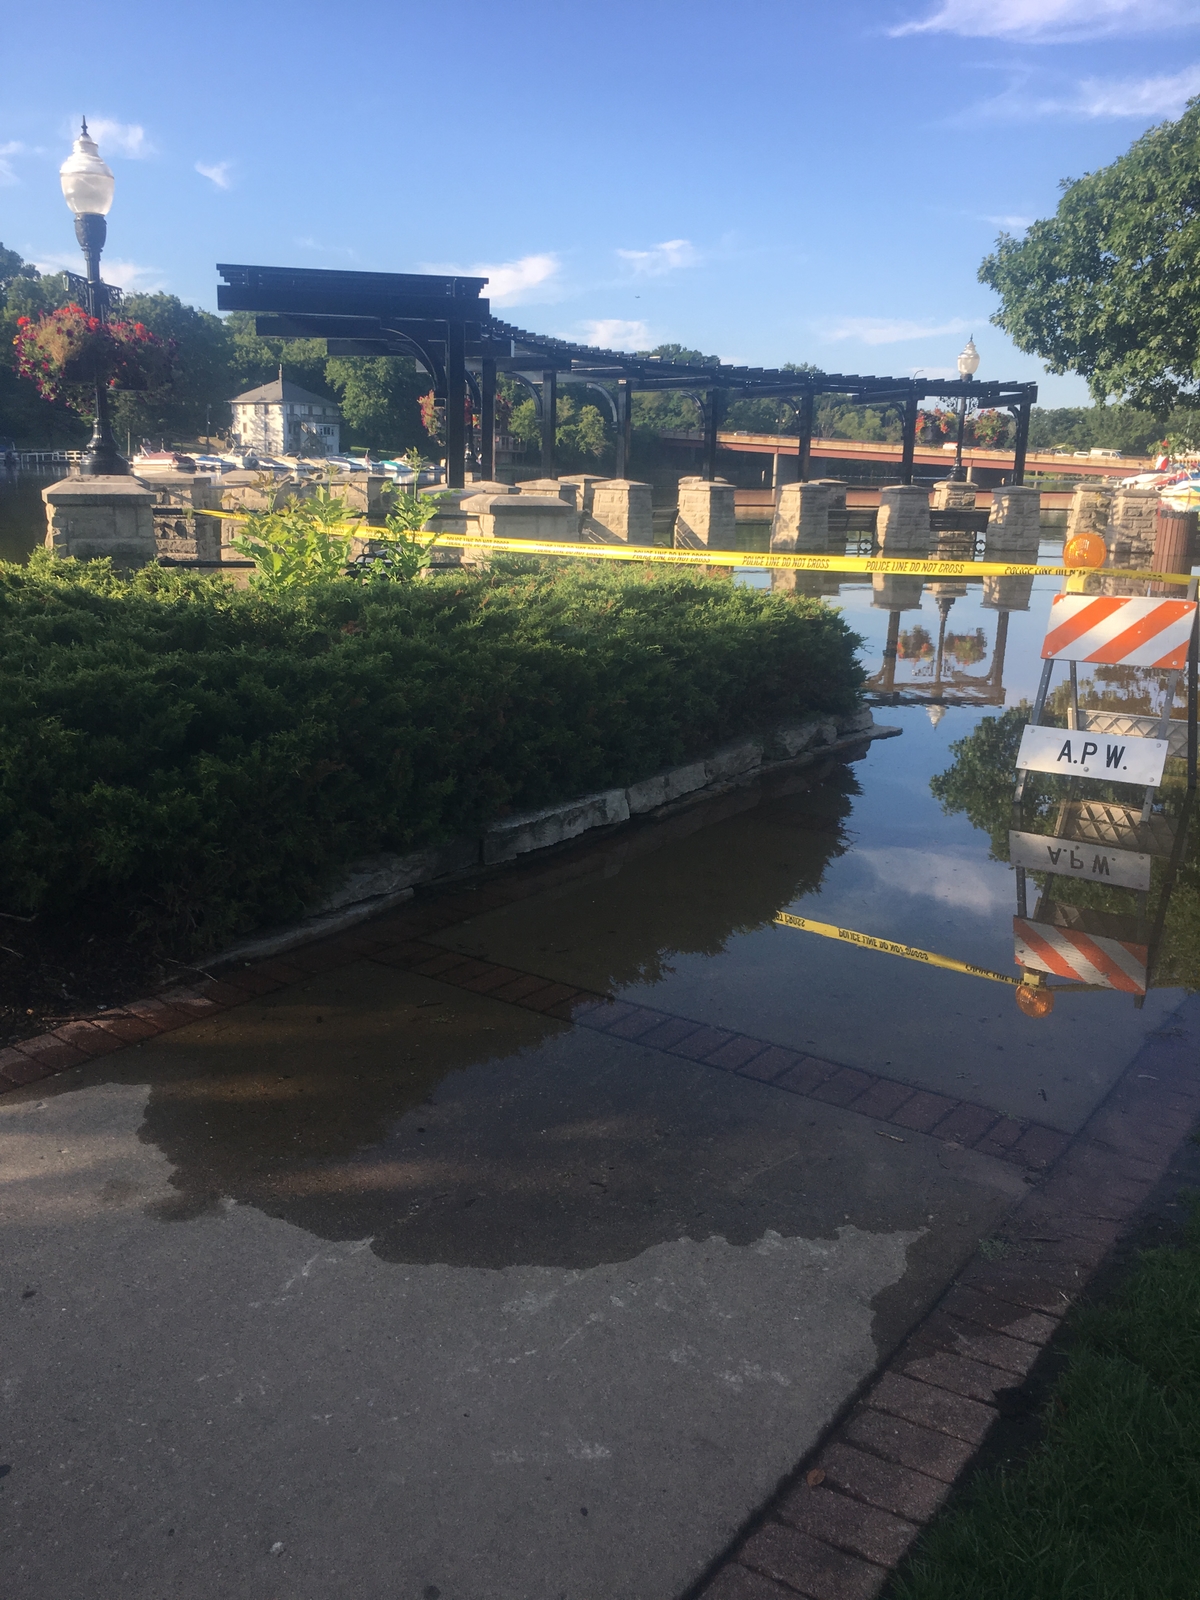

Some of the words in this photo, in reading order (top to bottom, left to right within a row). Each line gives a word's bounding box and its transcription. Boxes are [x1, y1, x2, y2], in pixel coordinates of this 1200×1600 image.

[742, 556, 765, 566] POLICE
[766, 556, 781, 566] LINE
[782, 557, 792, 567] DO
[792, 558, 807, 568] NOT
[806, 558, 830, 569] CROSS
[865, 561, 891, 572] POLICE
[891, 561, 909, 572] LINE
[909, 562, 920, 572] DO
[920, 562, 938, 573] NOT
[938, 563, 965, 574] CROSS
